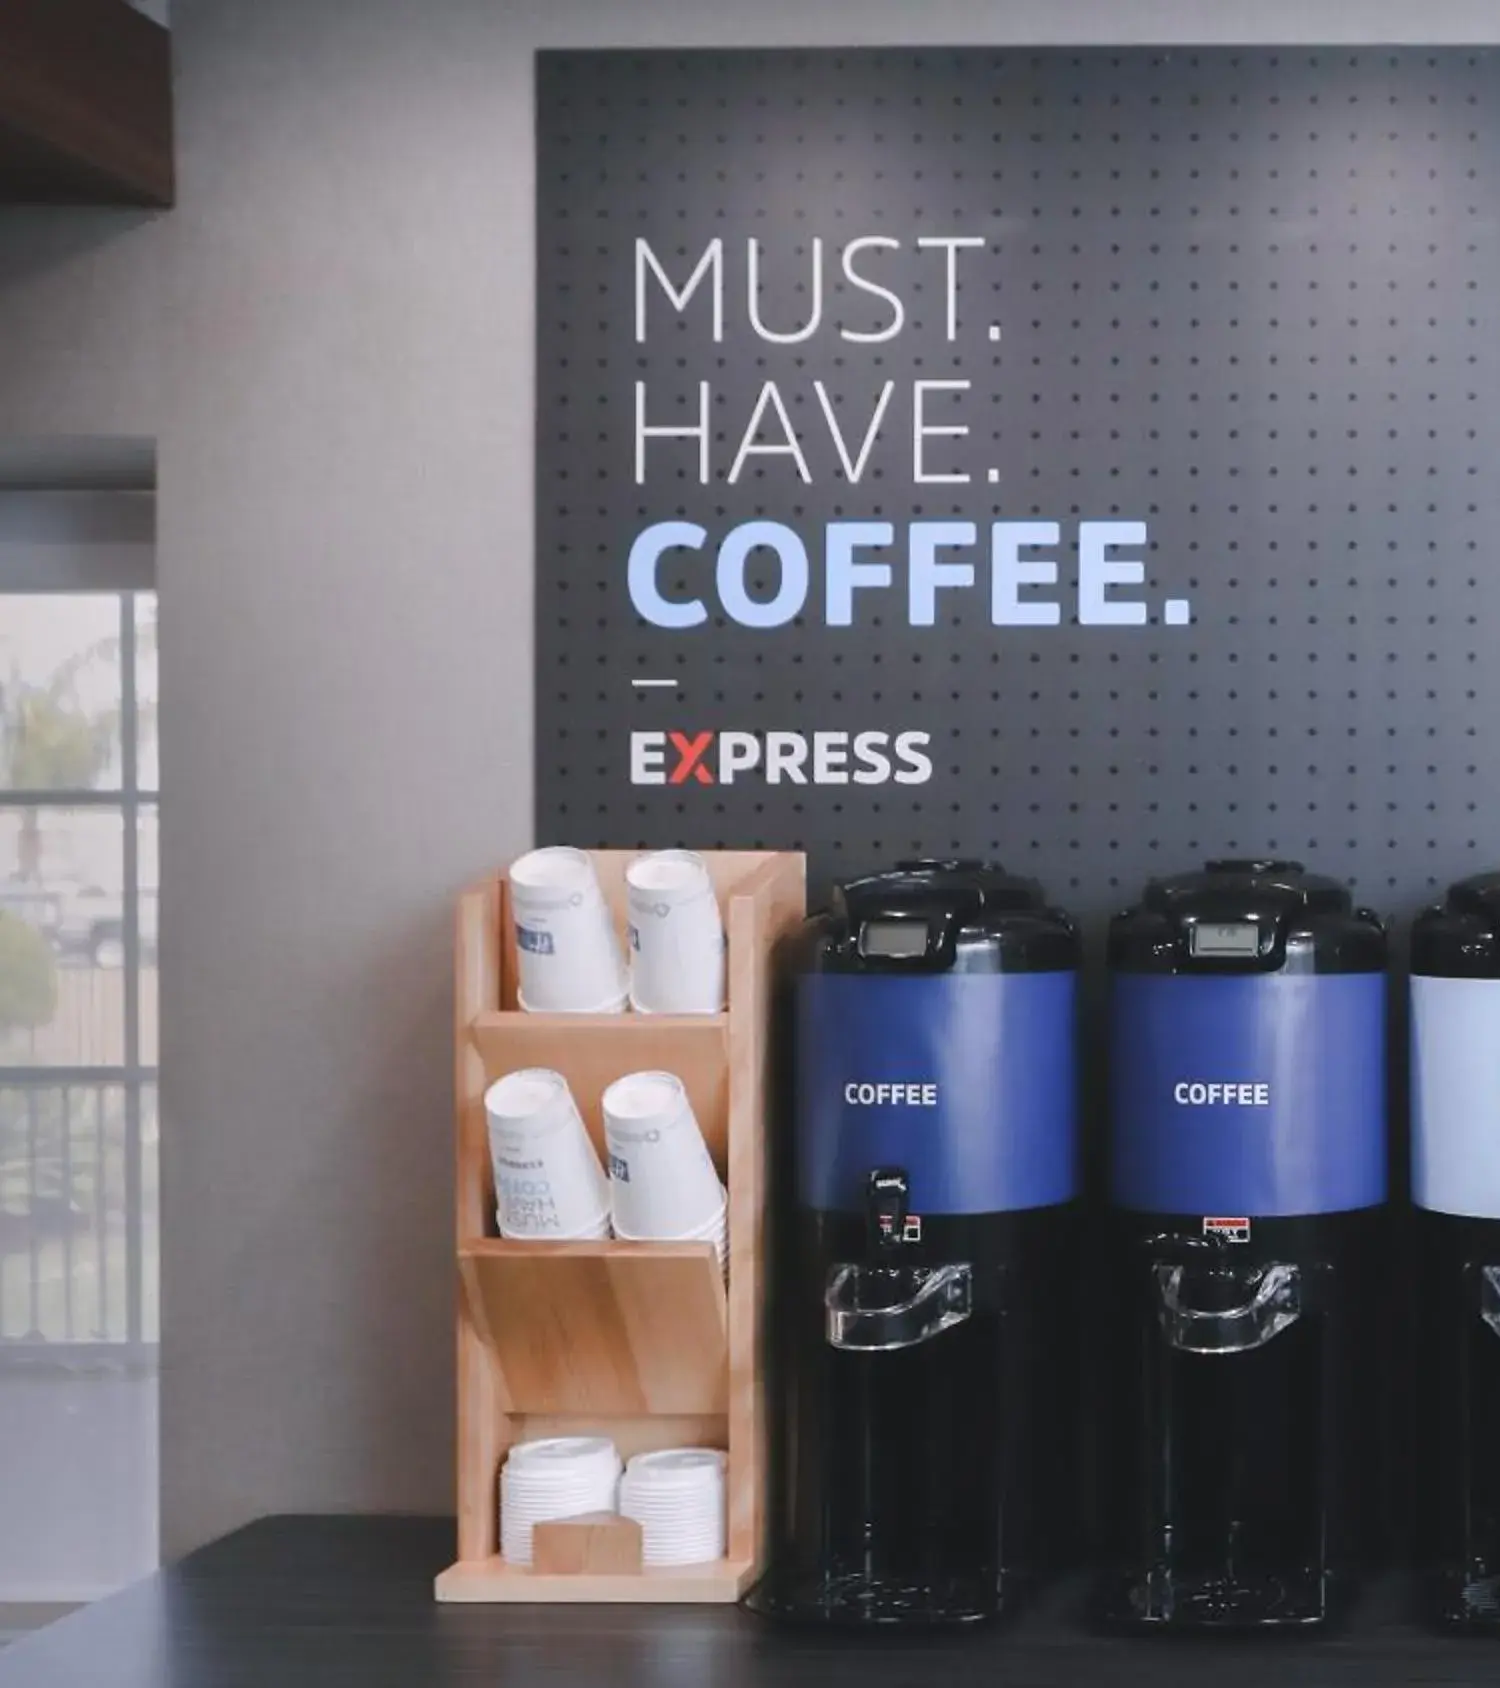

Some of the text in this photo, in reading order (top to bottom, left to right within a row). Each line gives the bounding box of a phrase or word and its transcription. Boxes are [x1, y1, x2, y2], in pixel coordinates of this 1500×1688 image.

[635, 237, 1000, 344] MUST.
[635, 380, 1000, 484] HAVE.
[627, 520, 1190, 628] COFFEE.
[630, 731, 933, 785] EXPRESS
[845, 1083, 937, 1105] COFFEE
[1174, 1083, 1269, 1105] COFFEE
